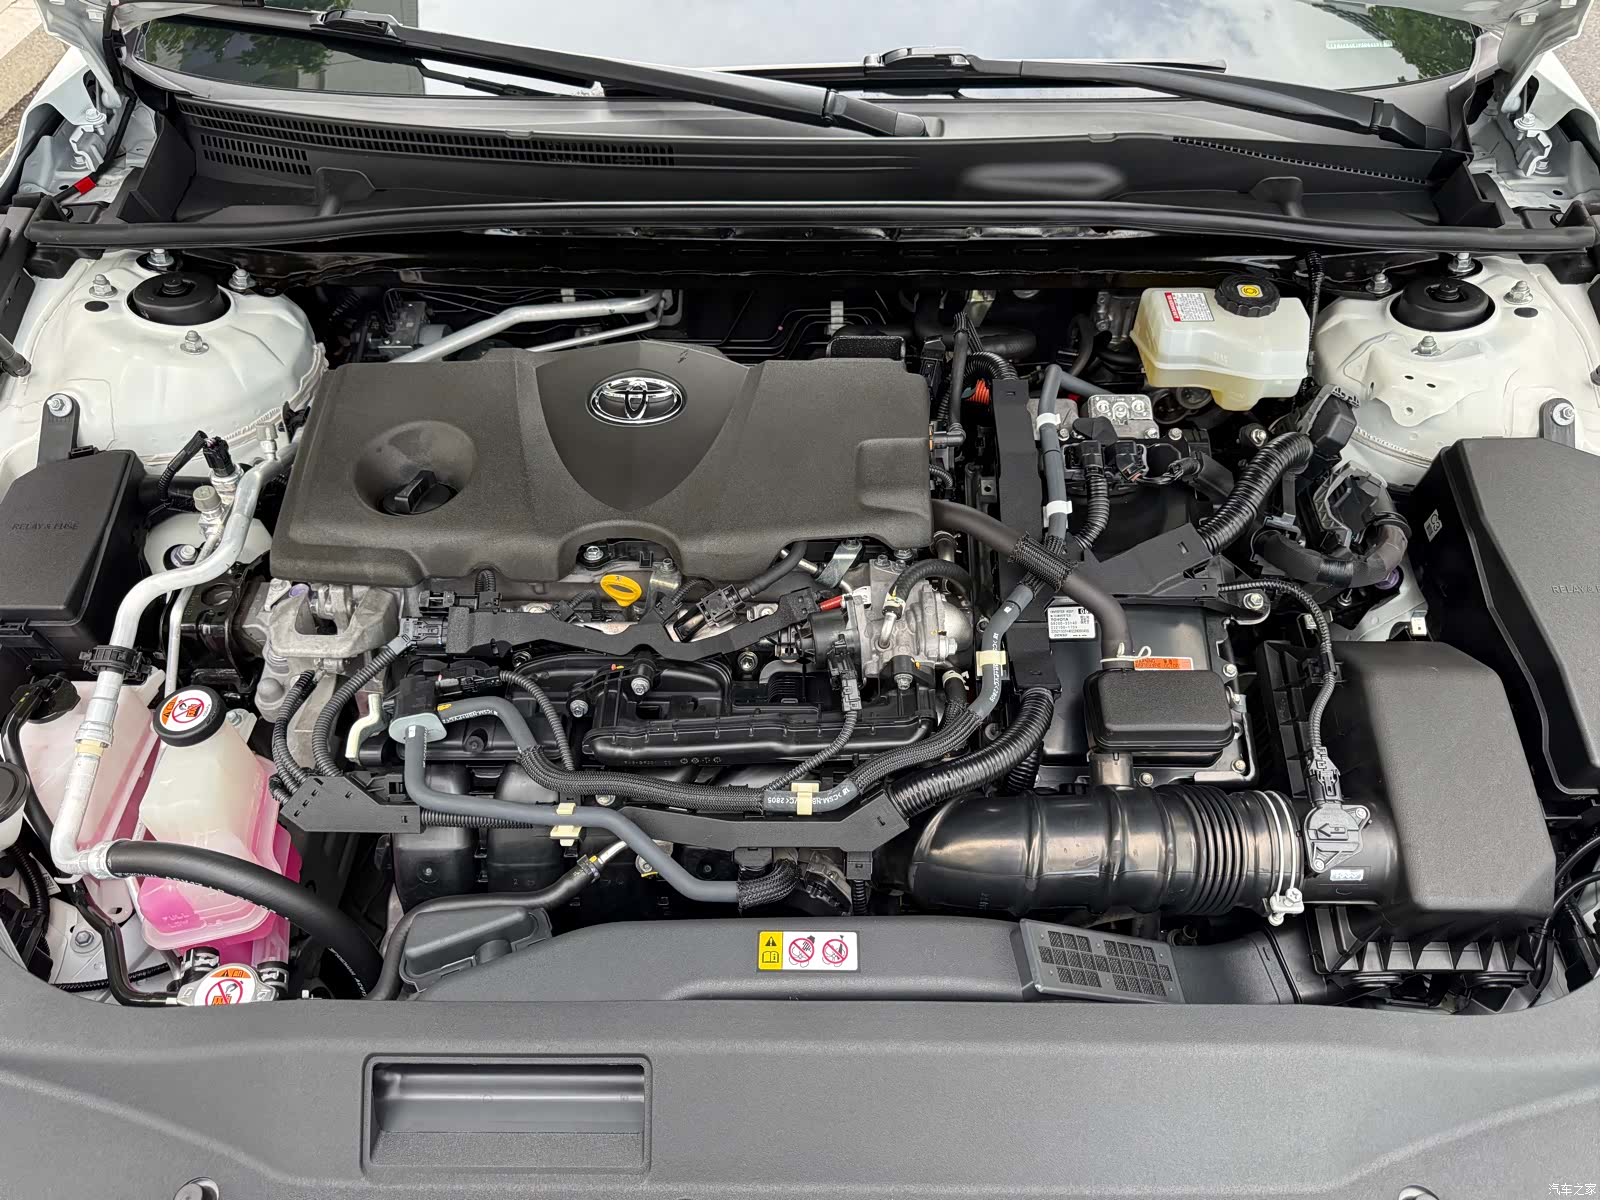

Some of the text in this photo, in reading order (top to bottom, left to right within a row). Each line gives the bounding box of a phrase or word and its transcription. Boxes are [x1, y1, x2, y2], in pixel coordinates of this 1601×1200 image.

[1431, 513, 1441, 532] C3
[1551, 585, 1584, 594] RELAY
[767, 796, 785, 804] 2805
